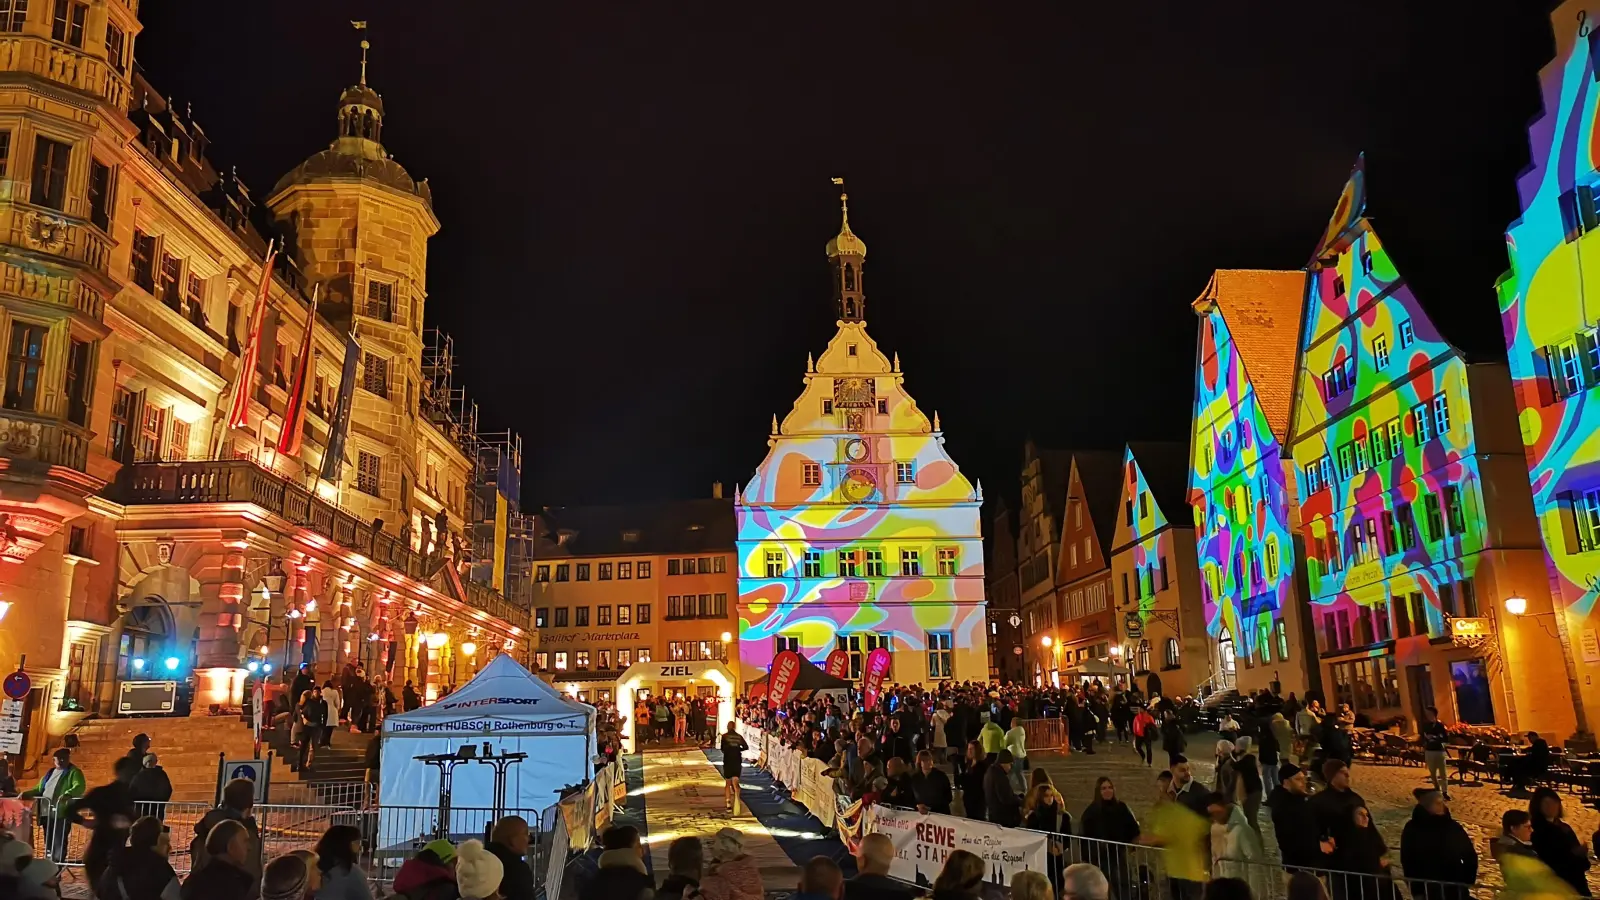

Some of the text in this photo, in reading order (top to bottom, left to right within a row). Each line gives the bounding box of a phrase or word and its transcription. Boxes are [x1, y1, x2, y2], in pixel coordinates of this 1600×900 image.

[582, 632, 640, 642] Marktplatz
[660, 666, 693, 676] ZIEL
[866, 653, 887, 695] REWE
[770, 656, 796, 705] REWE
[458, 697, 542, 708] INTERSPORT
[392, 722, 444, 732] Intersport
[494, 720, 553, 731] Rothenburg
[882, 817, 897, 828] Stahl
[915, 822, 956, 848] REWE
[973, 836, 982, 845] der
[984, 835, 1002, 848] Region
[915, 843, 948, 864] STAH
[991, 851, 1000, 860] die
[1002, 851, 1026, 866] Region!
